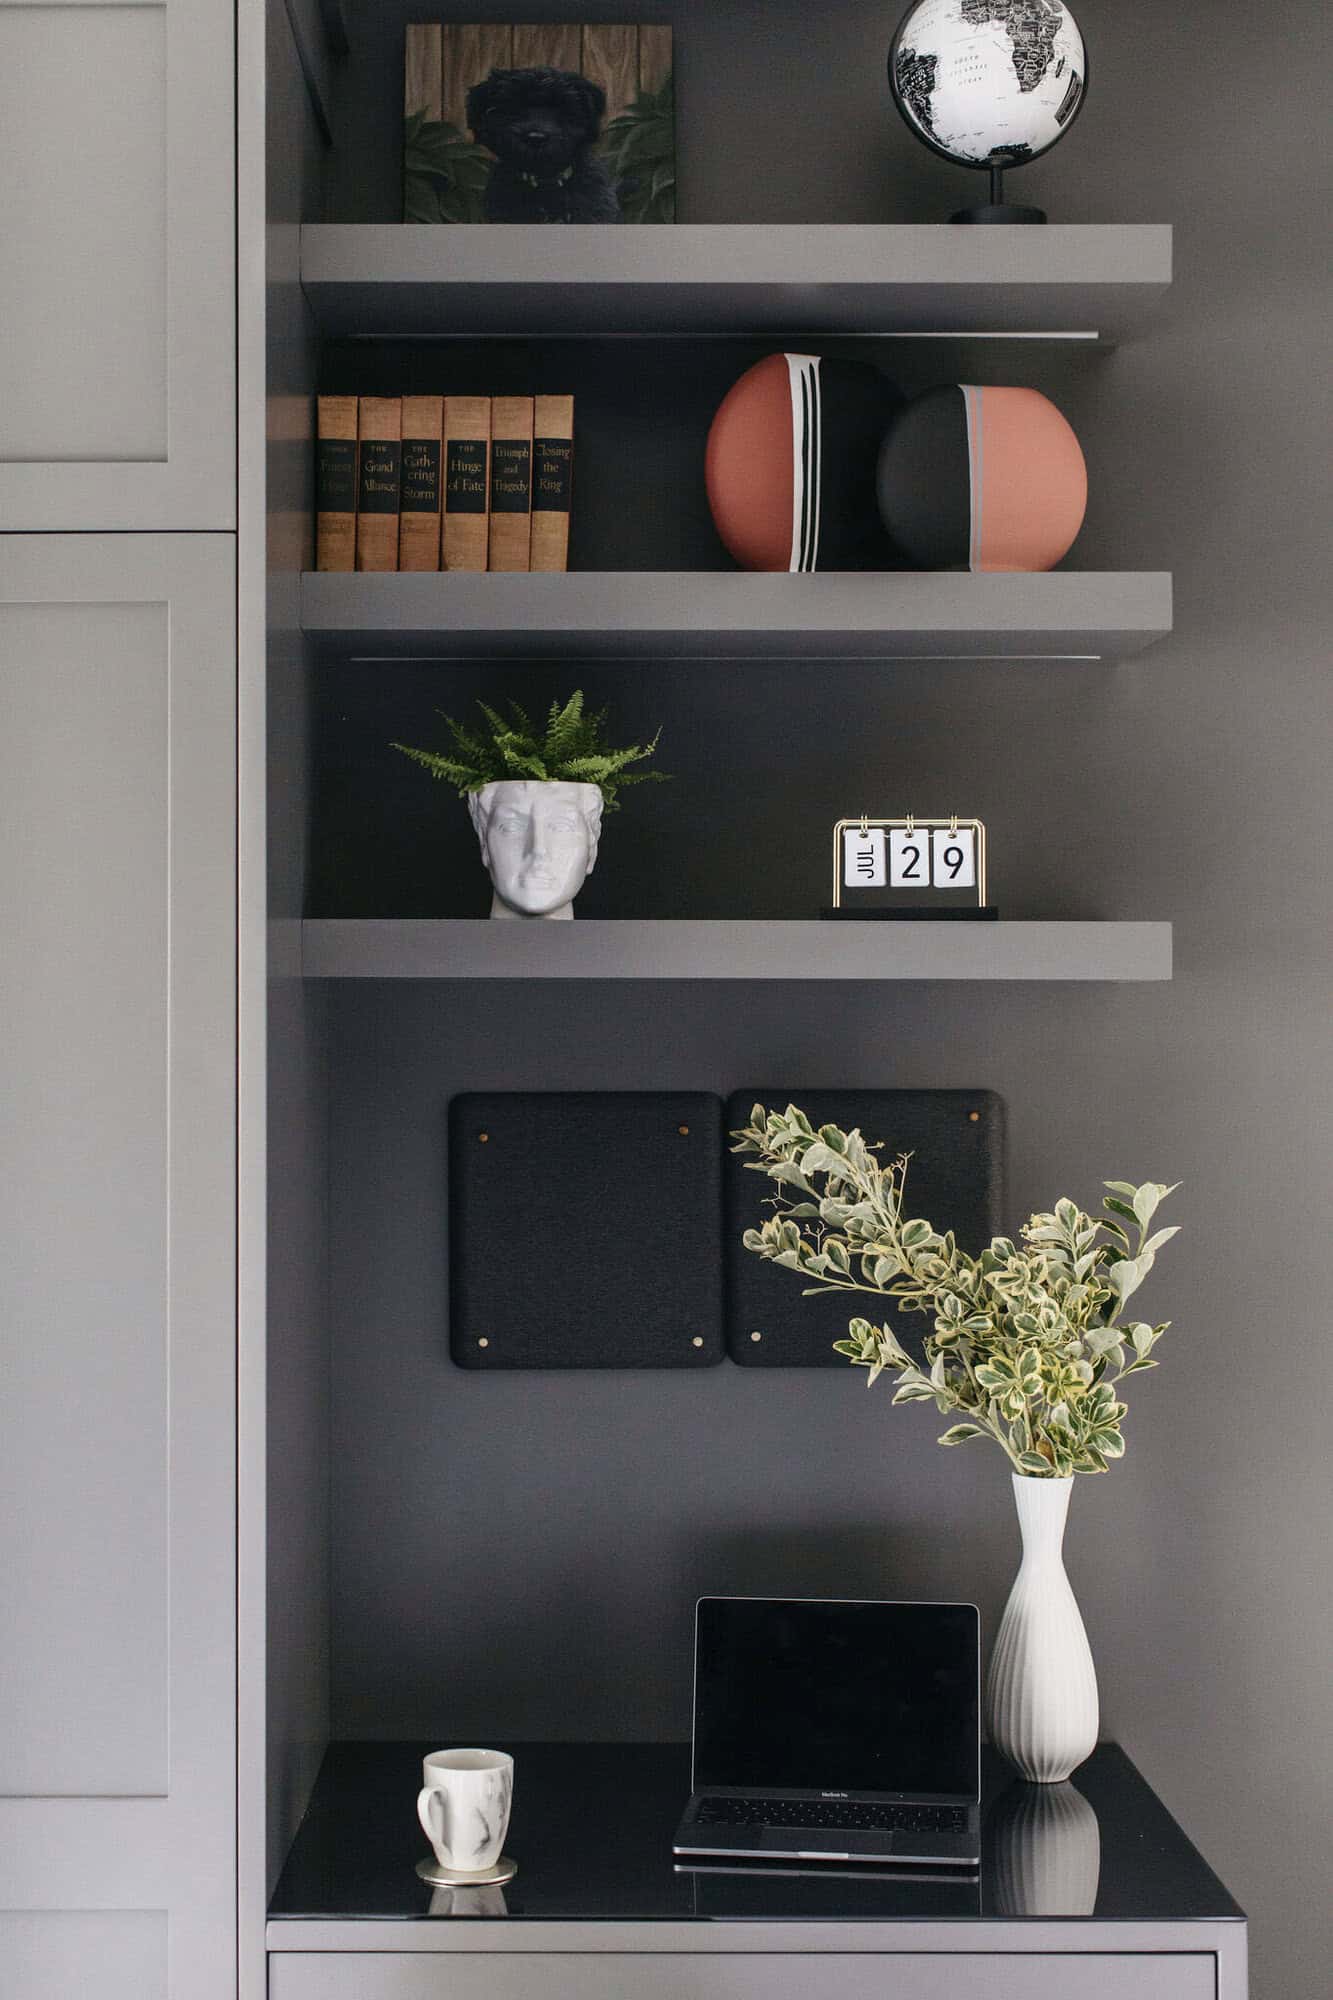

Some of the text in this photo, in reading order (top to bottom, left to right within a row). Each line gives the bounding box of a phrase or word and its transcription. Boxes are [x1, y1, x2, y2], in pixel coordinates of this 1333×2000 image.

[364, 460, 393, 473] Grand
[450, 458, 482, 473] Hinge
[543, 462, 559, 473] the
[463, 479, 484, 492] Fate
[495, 479, 528, 494] Tragedy
[539, 479, 562, 494] Ring
[403, 487, 435, 500] Storm
[857, 844, 964, 879] JUL 2 9
